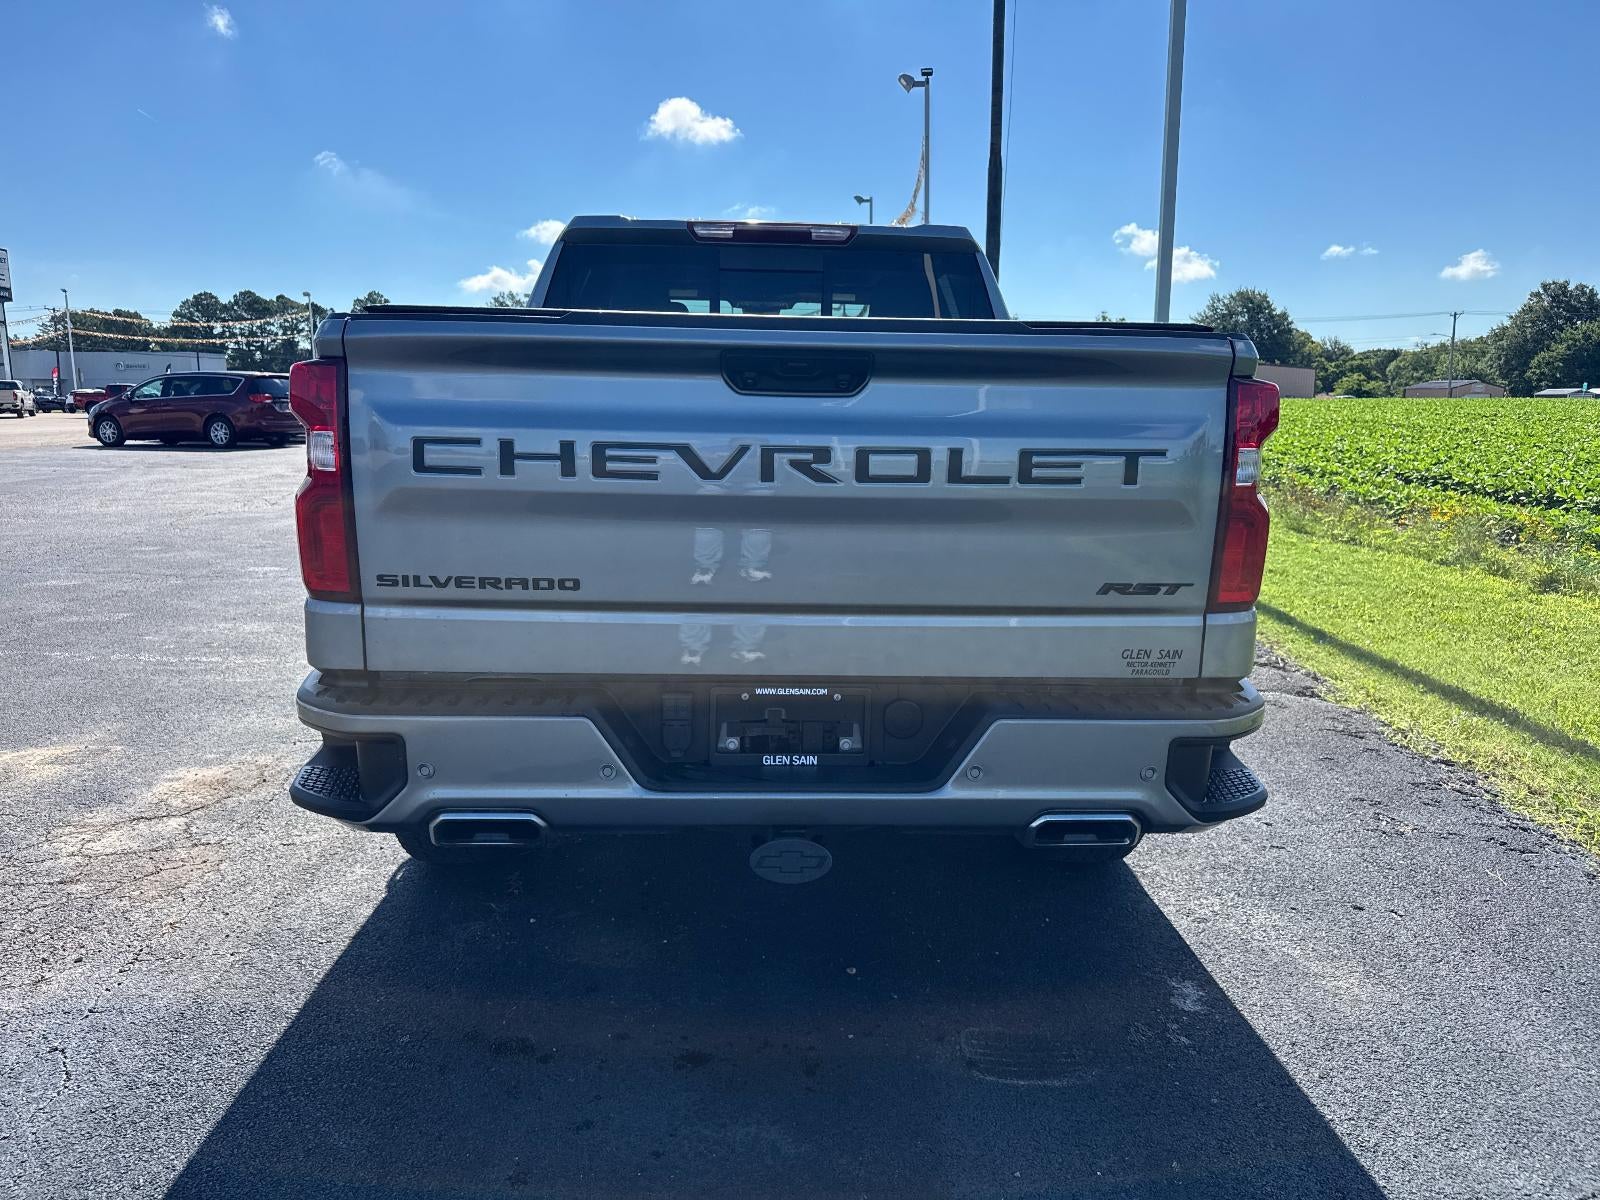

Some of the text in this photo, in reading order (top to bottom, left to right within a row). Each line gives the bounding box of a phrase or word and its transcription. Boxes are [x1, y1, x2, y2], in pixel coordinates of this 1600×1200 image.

[411, 435, 1169, 488] CHEVROLET
[376, 573, 582, 592] SILVERADO
[1095, 582, 1195, 595] RST
[1121, 648, 1183, 660] GLEN SAIN
[1130, 668, 1170, 676] PARAGOULD
[755, 688, 828, 696] WWW.GLENSAIN.COM
[762, 755, 818, 766] GLEN SAIN
